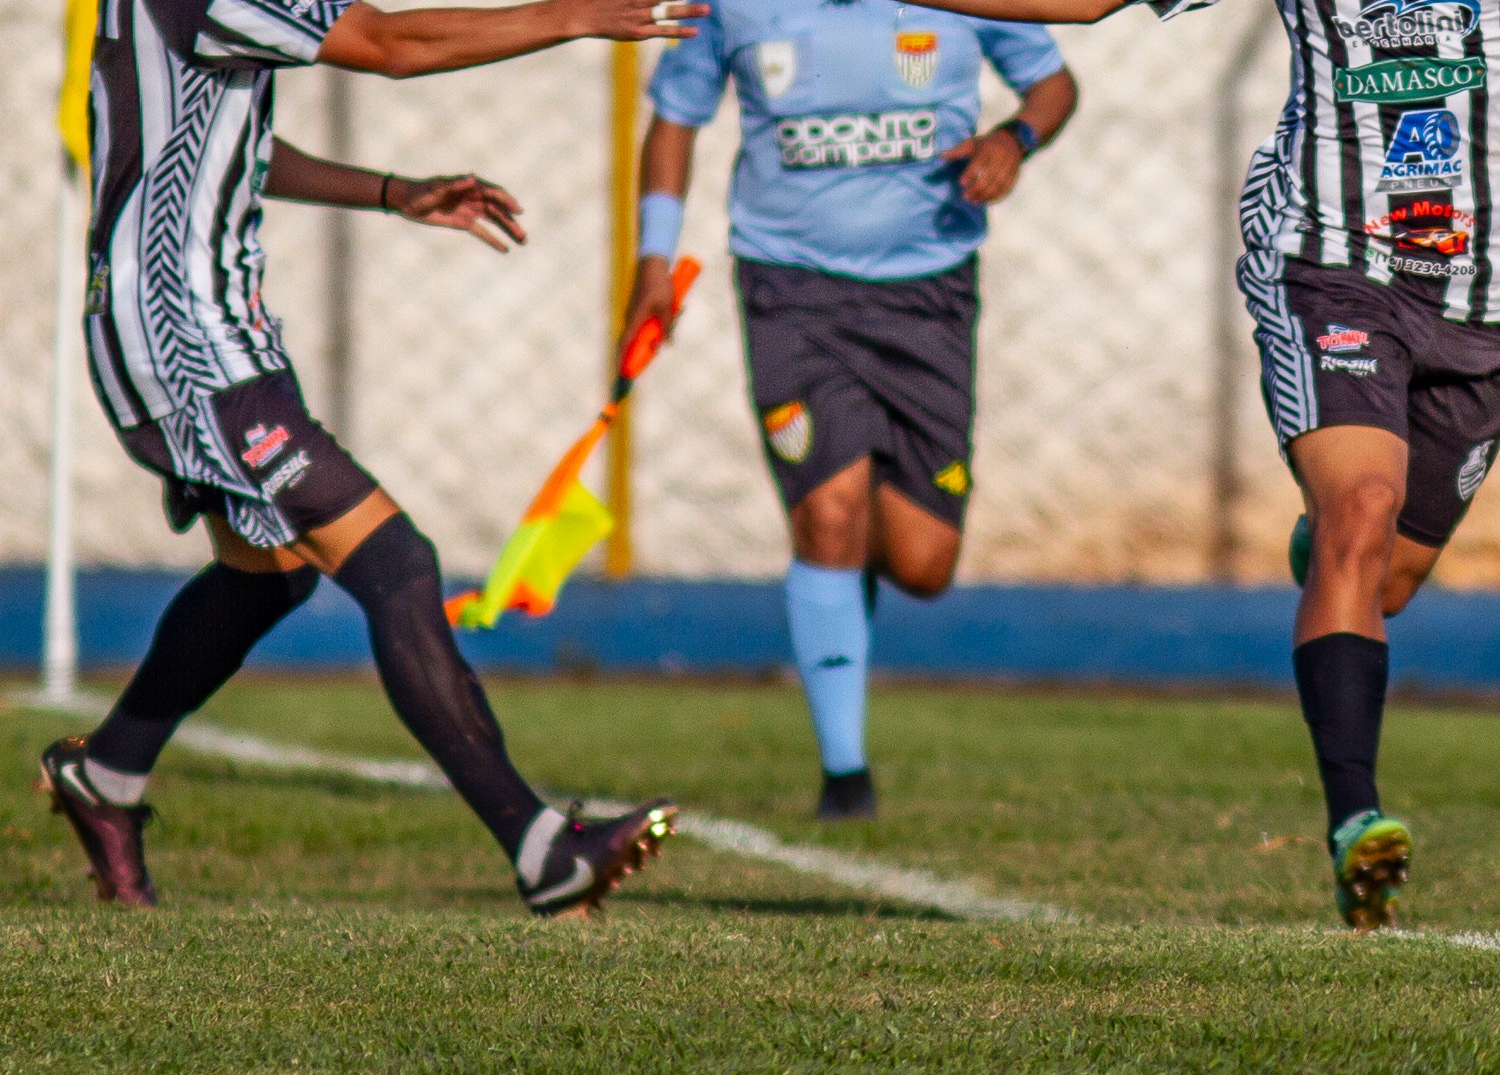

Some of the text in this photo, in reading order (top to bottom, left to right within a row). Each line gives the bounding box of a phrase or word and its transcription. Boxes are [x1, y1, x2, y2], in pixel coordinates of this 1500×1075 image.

[1331, 8, 1465, 41] bertolini
[1352, 35, 1451, 48] ENGENHARIA
[1346, 64, 1473, 96] DAMASCO
[777, 110, 937, 145] ODONTO
[781, 135, 935, 166] company
[1380, 159, 1462, 178] AGRIMAC
[1390, 178, 1452, 190] PNEUS
[1363, 200, 1477, 234] New Motors
[1404, 257, 1477, 276] 3234-4208
